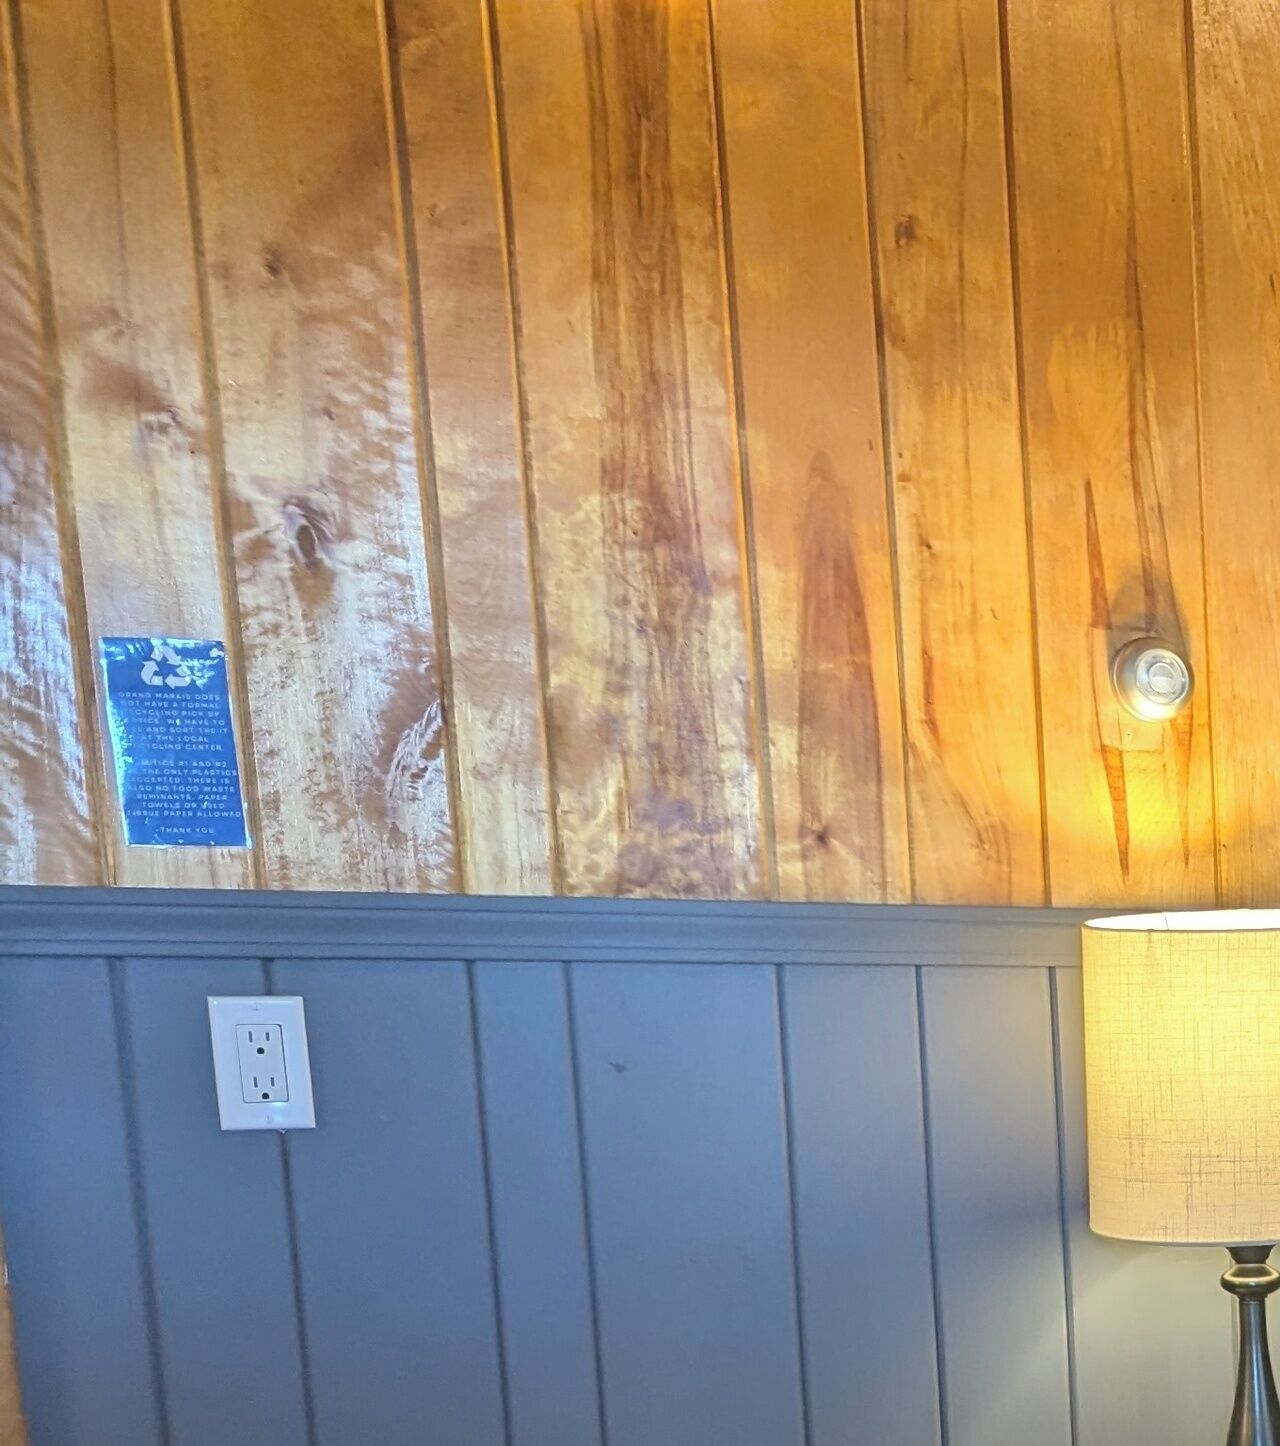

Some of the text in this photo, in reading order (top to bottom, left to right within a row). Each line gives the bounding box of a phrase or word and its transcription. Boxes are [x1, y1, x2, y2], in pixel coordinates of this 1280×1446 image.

[144, 700, 169, 708] HAVE
[184, 719, 210, 727] HAVE
[212, 719, 225, 727] TO
[156, 734, 175, 742] THE
[163, 768, 189, 776] ONLY
[155, 784, 169, 792] NO
[172, 785, 200, 793] FOOD
